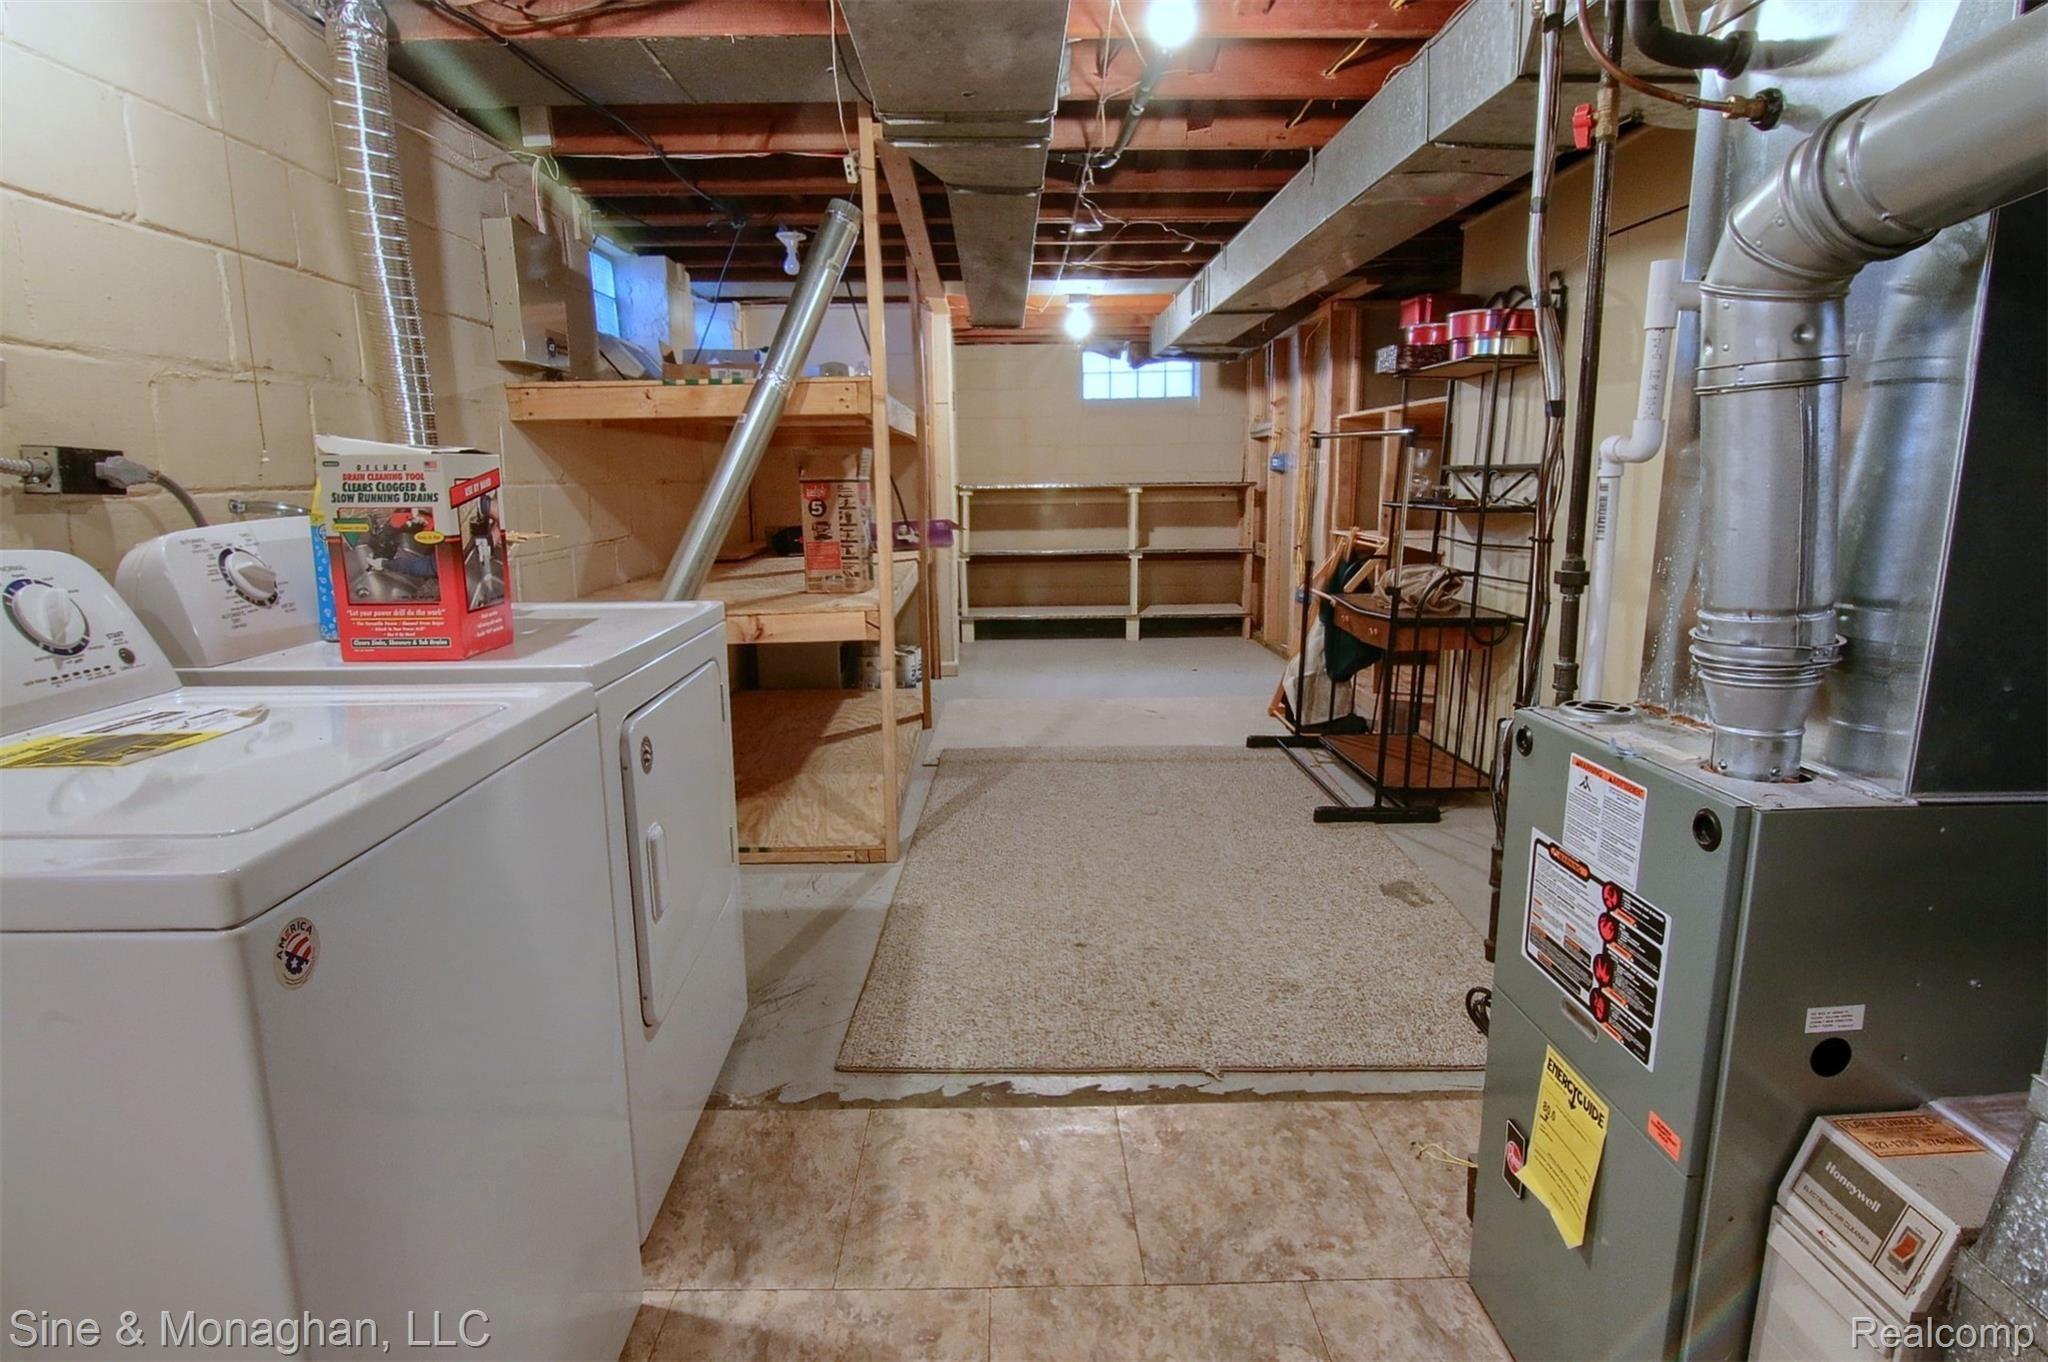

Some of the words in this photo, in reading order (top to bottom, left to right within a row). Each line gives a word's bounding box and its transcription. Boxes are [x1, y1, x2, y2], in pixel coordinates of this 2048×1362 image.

[342, 473, 365, 481] DRAIN
[367, 473, 403, 481] CLEANING
[405, 472, 425, 481] TOOL
[342, 481, 373, 492] CLEARS
[375, 481, 417, 492] CLOGGED
[419, 482, 427, 492] &
[331, 492, 356, 503] SLOW
[357, 492, 401, 503] RUNNING
[403, 492, 440, 503] DRAINS
[811, 501, 824, 517] 5
[1825, 1161, 1881, 1213] Honeywell
